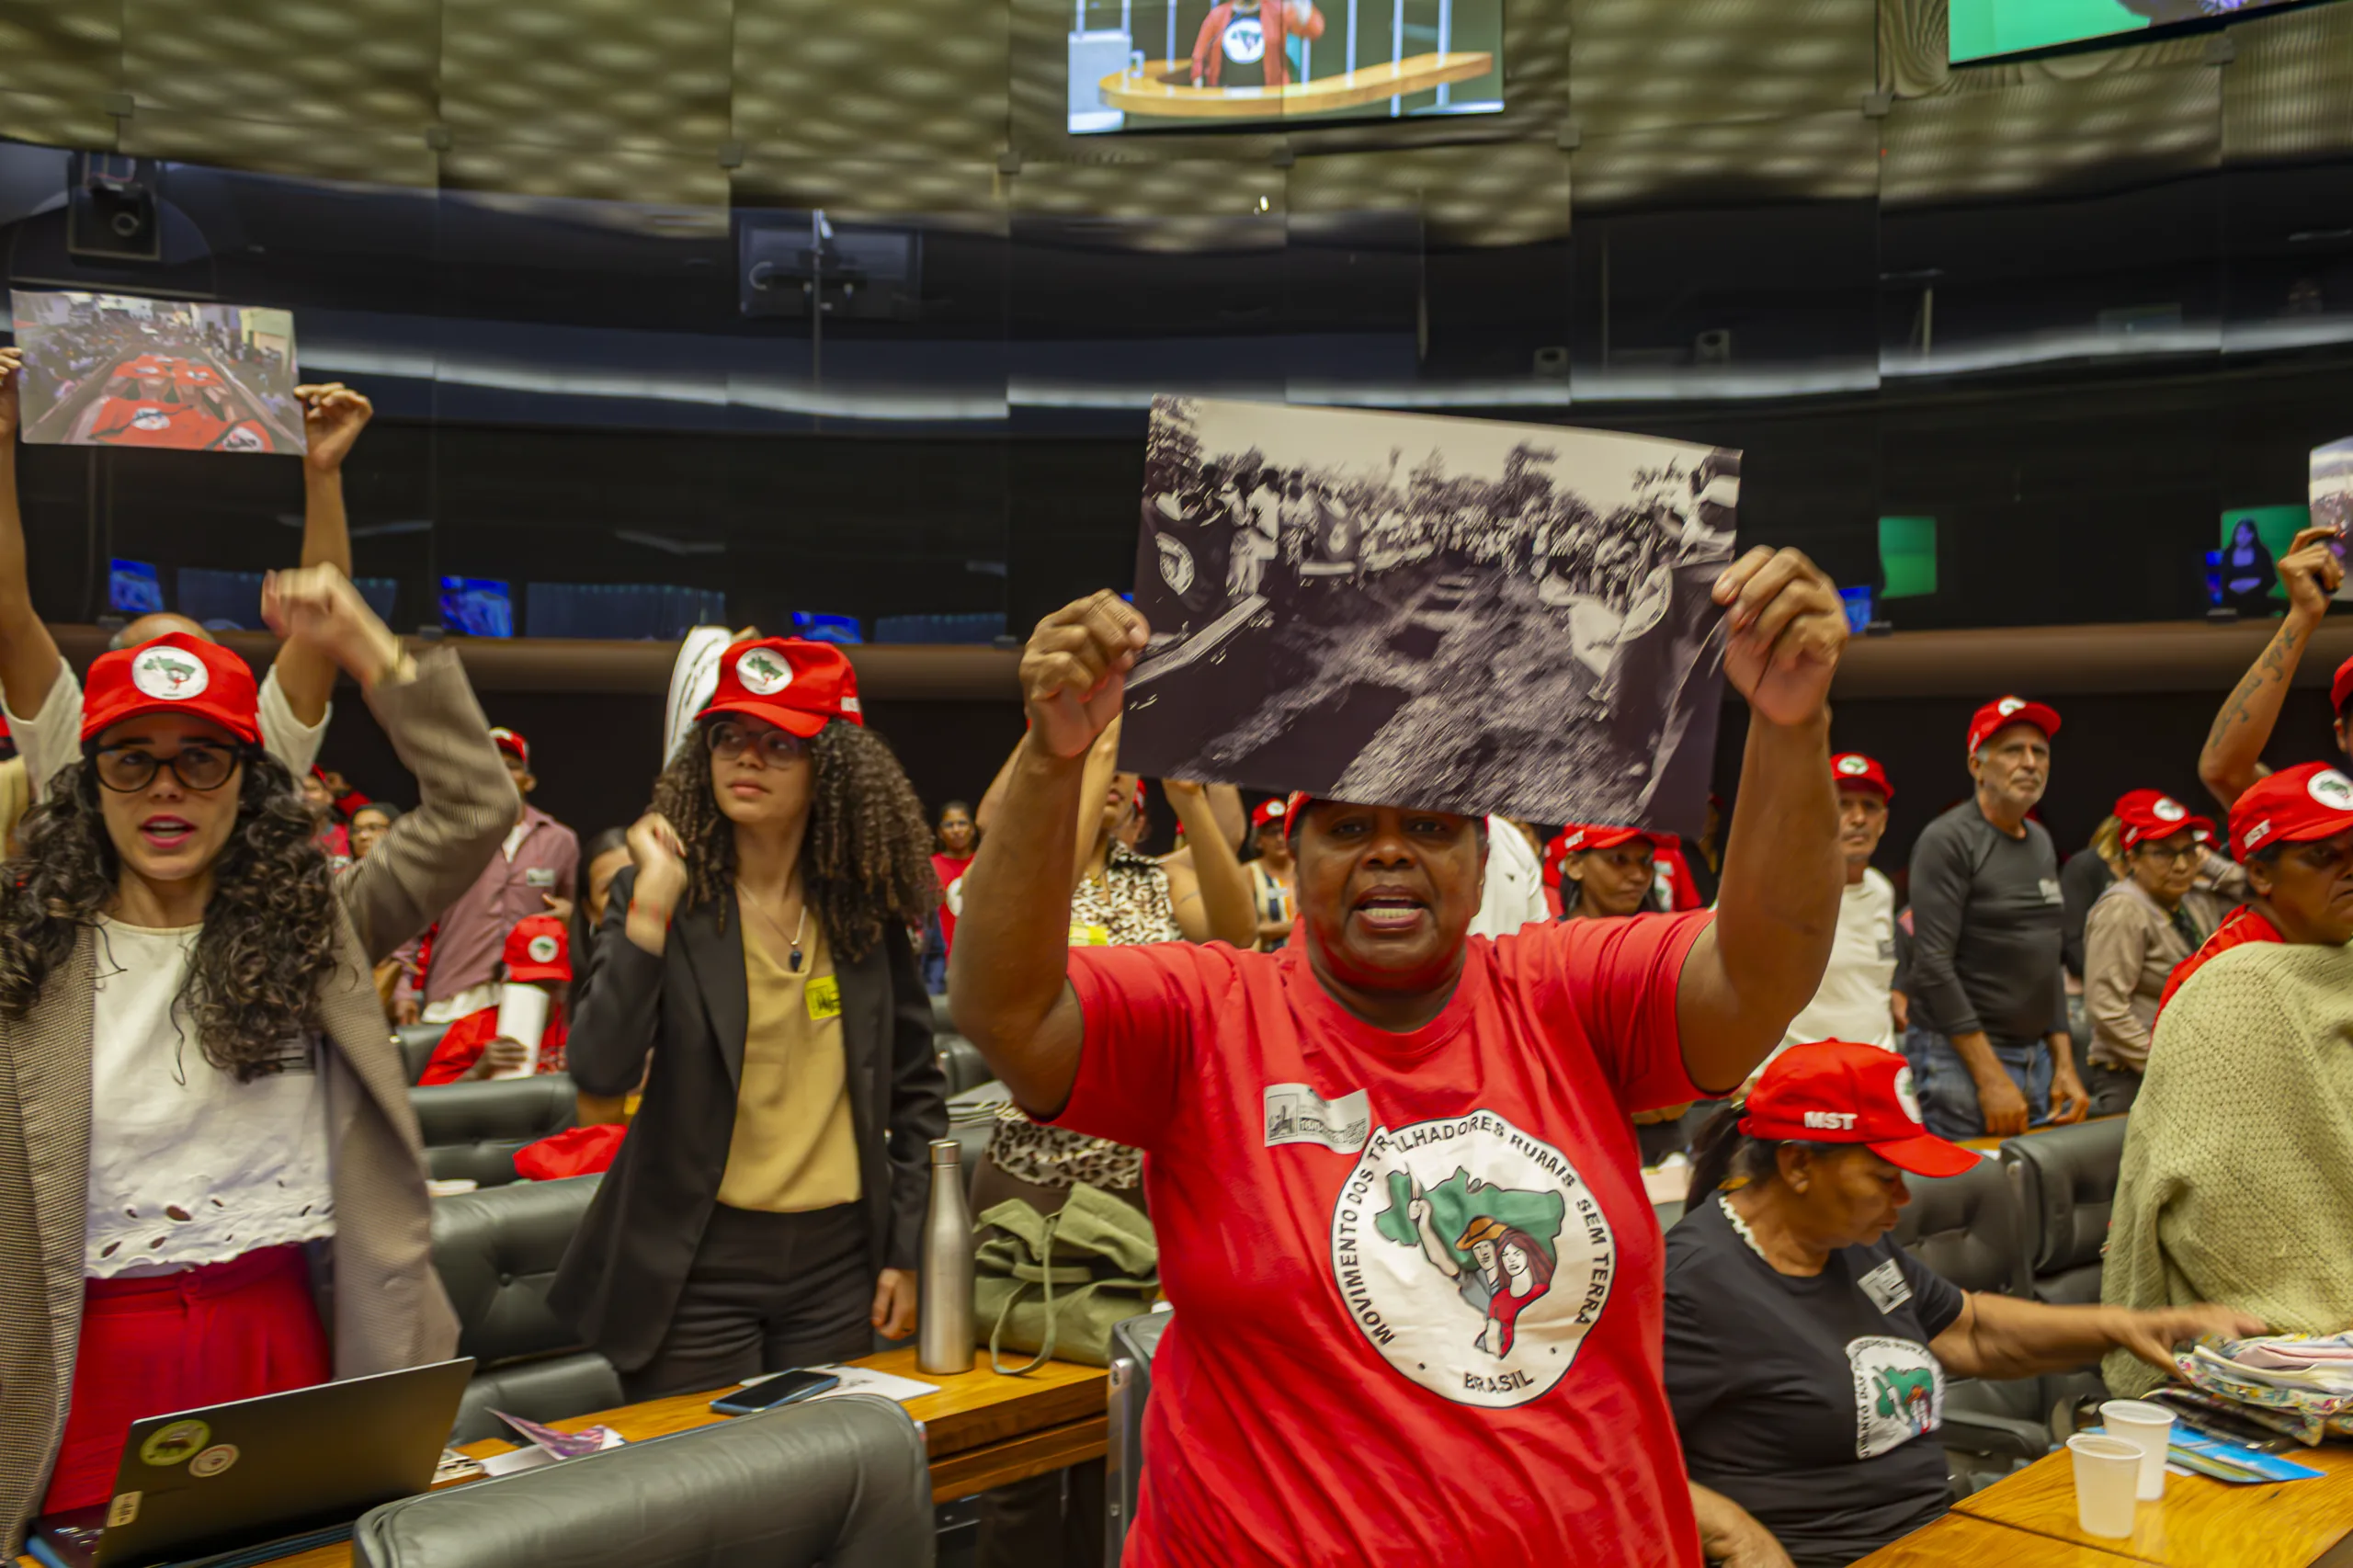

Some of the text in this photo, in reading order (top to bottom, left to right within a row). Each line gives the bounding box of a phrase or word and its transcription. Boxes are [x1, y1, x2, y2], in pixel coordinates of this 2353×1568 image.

[1367, 1116, 1505, 1162] TRLHADORES
[1804, 1110, 1858, 1130] MST
[1509, 1134, 1575, 1187] RURAIS
[1347, 1168, 1374, 1206] DOS
[1576, 1199, 1608, 1245] SEM
[1338, 1209, 1396, 1346] MOVIMENTO
[1574, 1253, 1610, 1325] TERRA
[1464, 1369, 1534, 1393] BRASIL
